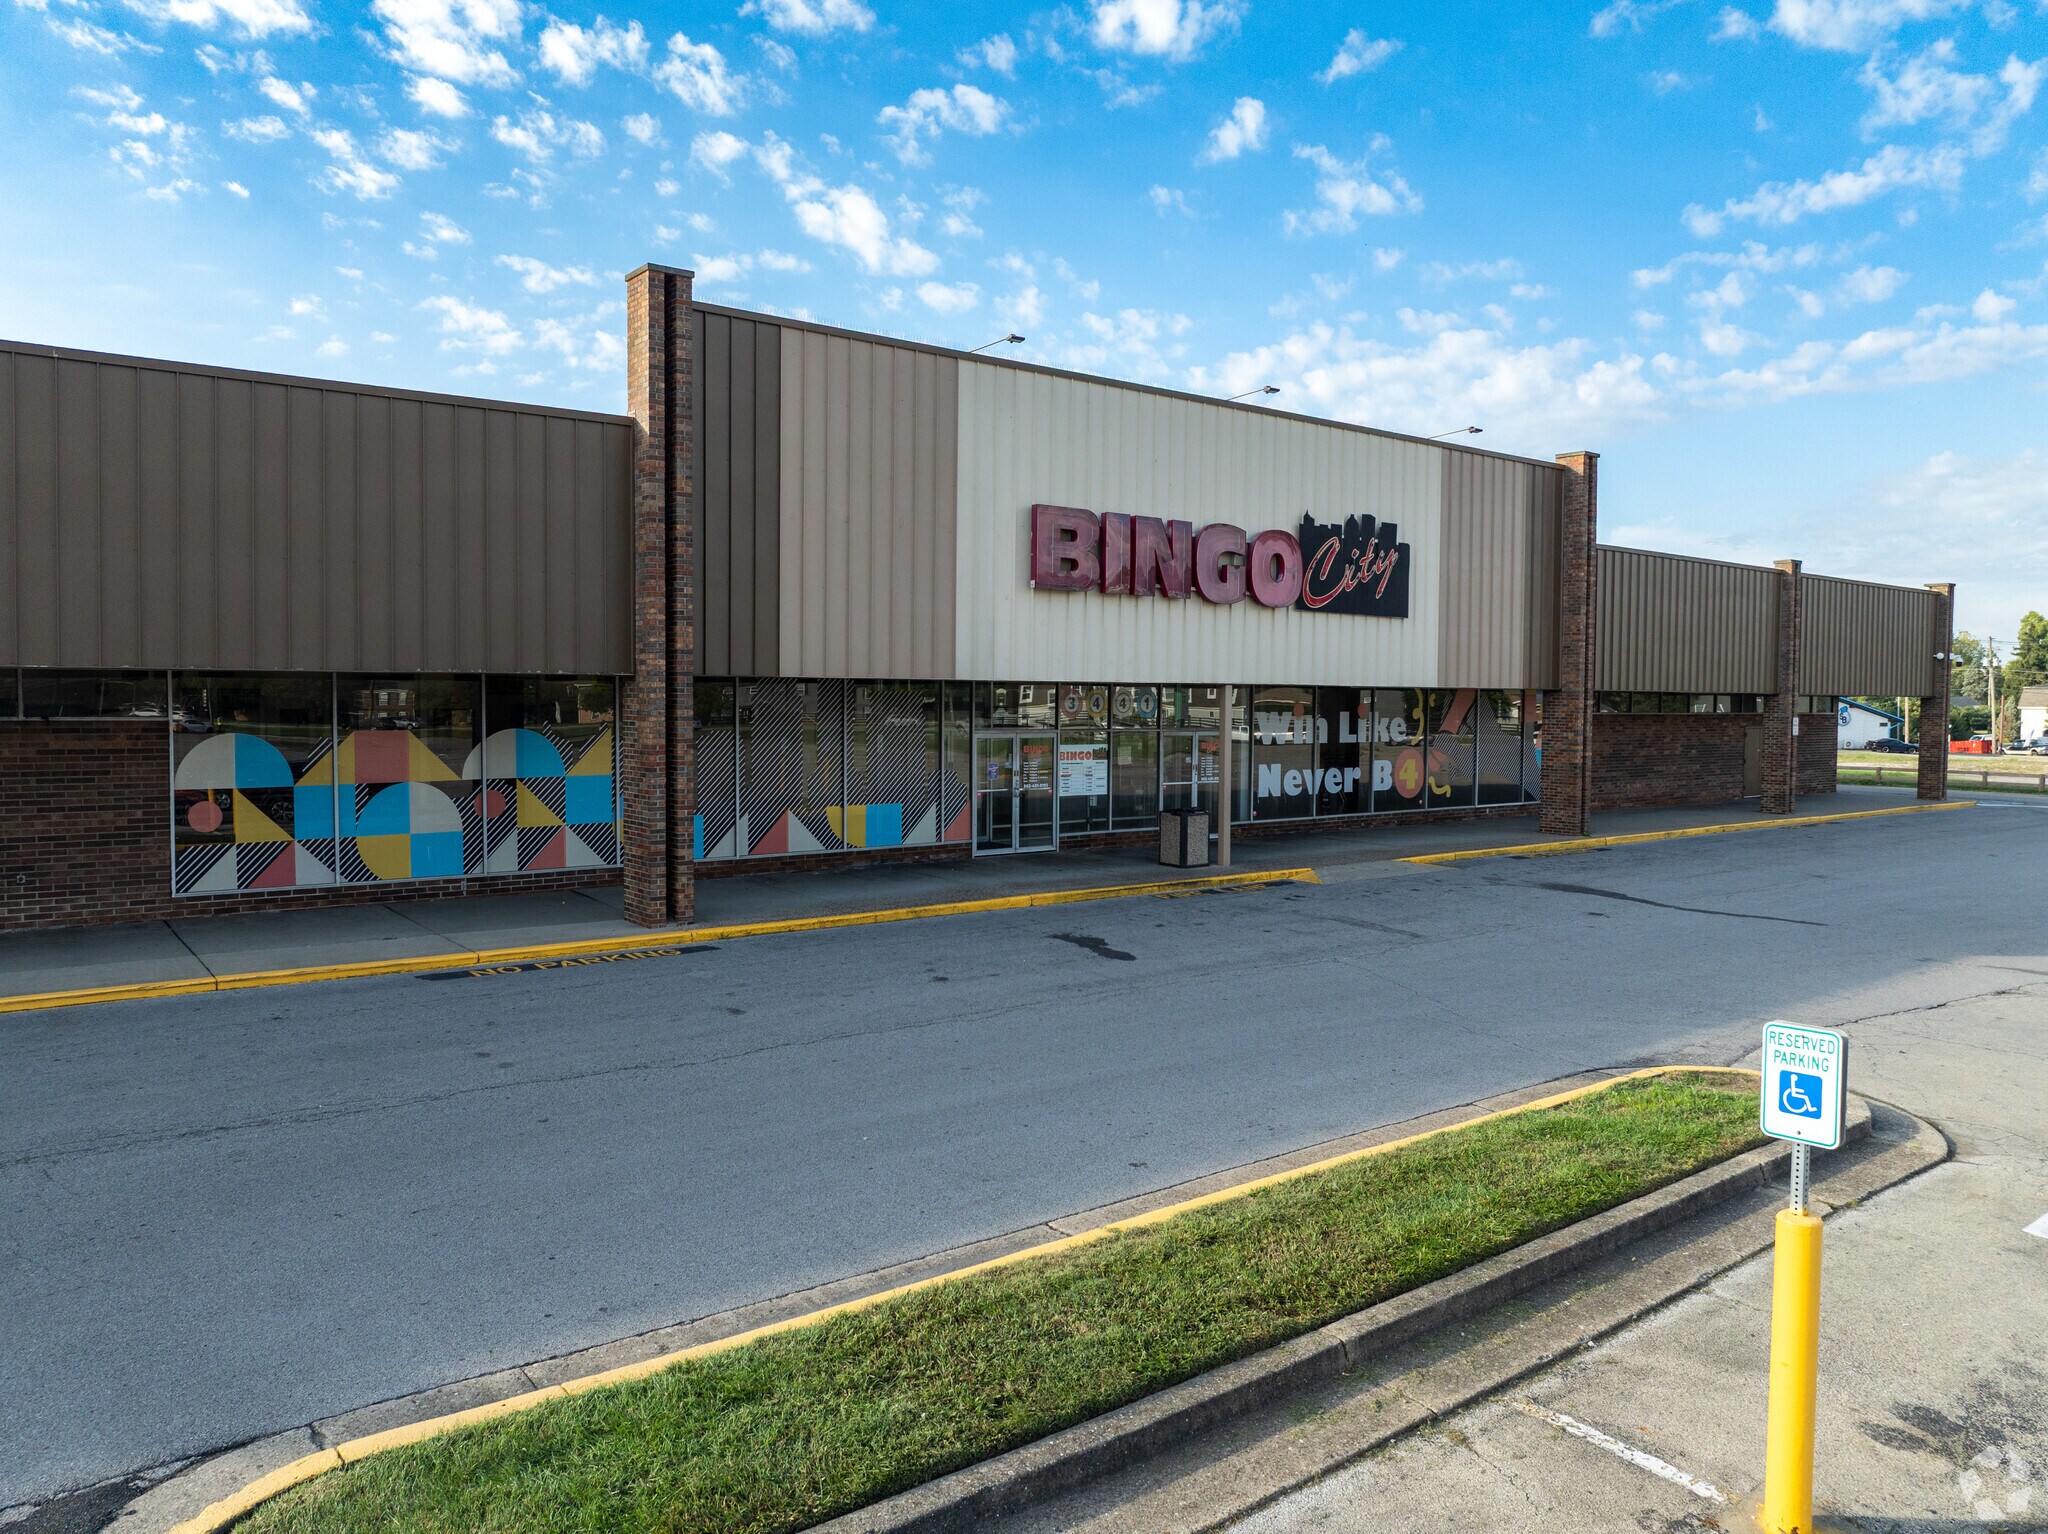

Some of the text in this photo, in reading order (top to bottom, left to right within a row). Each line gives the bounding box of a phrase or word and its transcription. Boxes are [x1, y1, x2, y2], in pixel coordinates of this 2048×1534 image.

[1031, 503, 1400, 608] BINGO City
[1256, 703, 1408, 746] Win Like
[1059, 751, 1092, 761] BINGO
[1258, 763, 1361, 798] Never
[1373, 758, 1419, 792] B4
[469, 948, 683, 978] NO PARKING
[1769, 1031, 1836, 1055] RESERVED
[1774, 1050, 1829, 1072] PARKING
